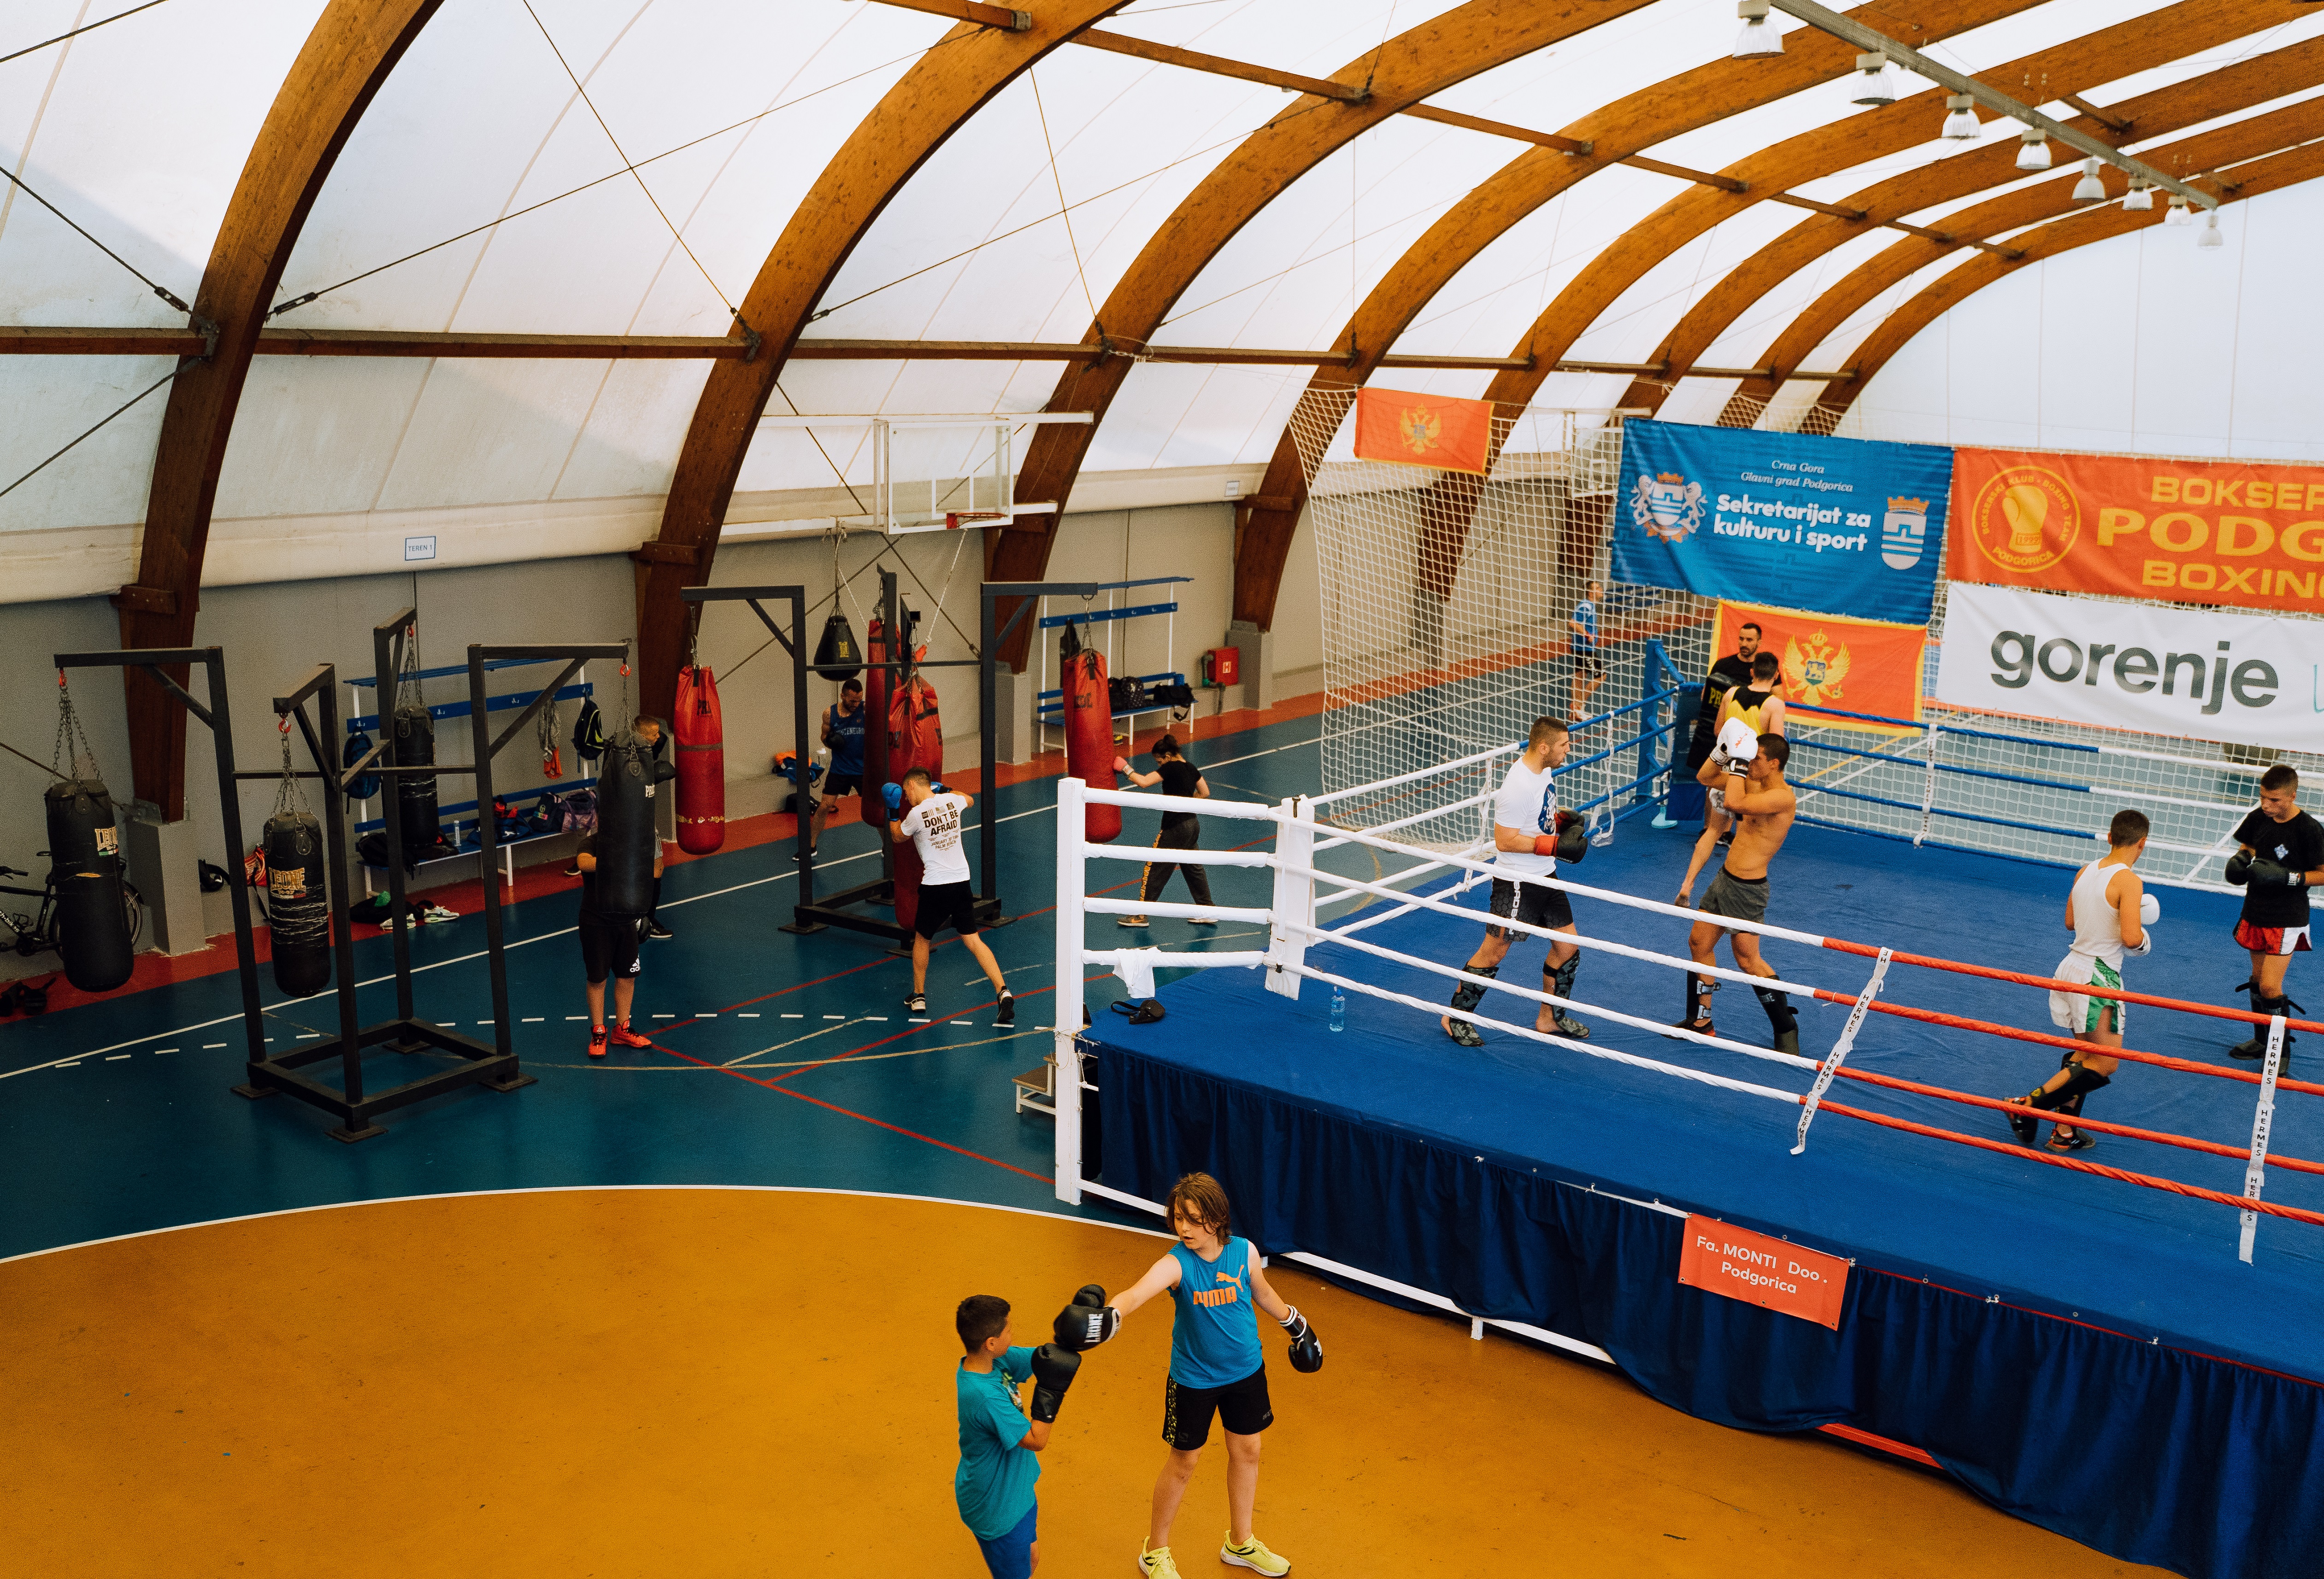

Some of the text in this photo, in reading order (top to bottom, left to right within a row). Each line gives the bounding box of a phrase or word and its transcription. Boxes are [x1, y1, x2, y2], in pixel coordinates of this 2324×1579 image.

[1741, 472, 1853, 492] Glavni grad Podgorica
[1771, 460, 1825, 474] Crna Gora
[2008, 475, 2035, 485] KLUB
[2042, 480, 2070, 510] BOXING
[1716, 494, 1871, 528] Sekretarijat za
[1713, 513, 1868, 553] kulturu i sport
[1992, 546, 2054, 566] PODGORICA
[2142, 560, 2324, 599] BOXIN
[1990, 630, 2279, 716] gorenje
[924, 810, 959, 828] DON'T BE
[930, 819, 957, 836] AFRAID
[269, 867, 306, 892] LEONE
[1847, 994, 1869, 1033] HERMES
[1817, 1052, 1840, 1090] HERMES
[2266, 1036, 2279, 1084] HERMES
[2255, 1109, 2268, 1156] HERMES
[1696, 1235, 1719, 1253] Fa.
[1723, 1243, 1777, 1269] MONTI
[1721, 1261, 1797, 1294] Podgorica
[1193, 1286, 1237, 1308] PUMA
[1084, 1313, 1104, 1343] LEONE
